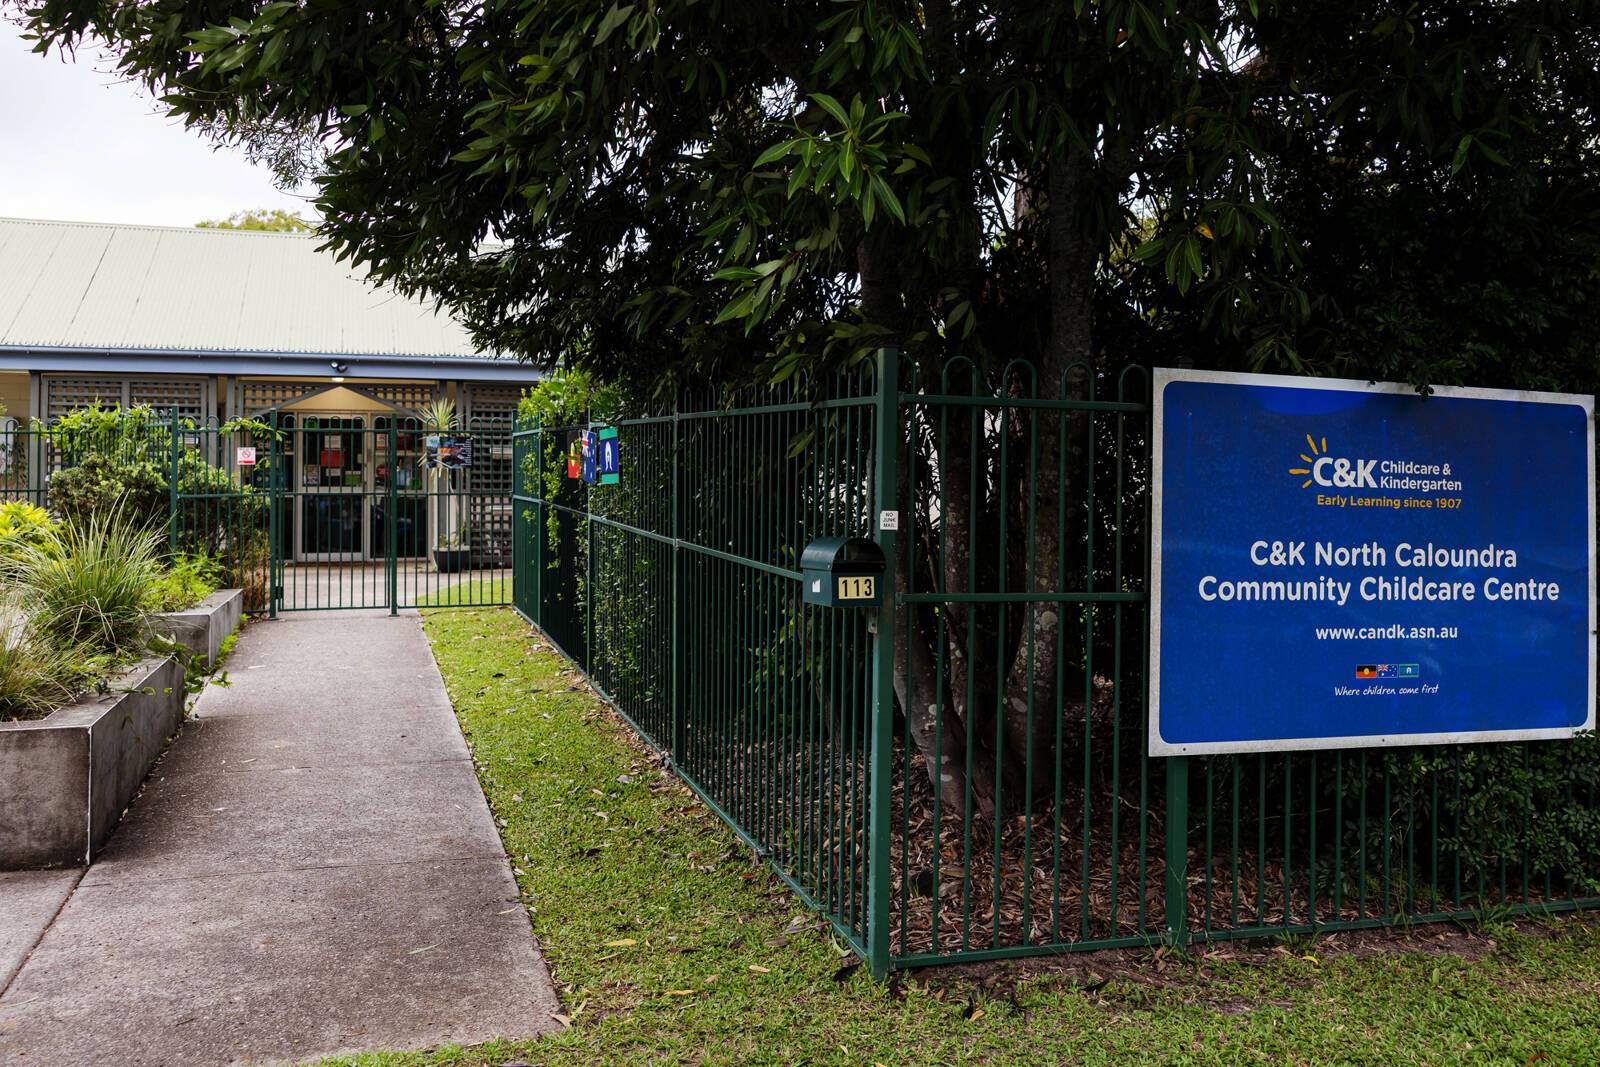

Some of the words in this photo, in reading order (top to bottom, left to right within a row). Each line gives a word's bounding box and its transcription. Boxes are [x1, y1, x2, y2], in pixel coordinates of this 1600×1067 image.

[1313, 456, 1379, 488] C&K
[1380, 460, 1440, 475] Childcare
[1442, 463, 1452, 476] &
[1380, 476, 1462, 492] Kindergarten
[1317, 494, 1347, 507] Early
[1350, 495, 1401, 509] Learning
[1403, 497, 1433, 508] since
[1436, 498, 1462, 509] 1907
[1250, 540, 1306, 566] C&K
[1315, 541, 1386, 566] North
[1395, 542, 1517, 568] Caloundra
[841, 578, 872, 597] 113
[1198, 575, 1351, 606] Community
[1360, 576, 1476, 601] Childcare
[1483, 577, 1560, 601] Centre
[1315, 624, 1458, 640] www.candk.asn.au
[1334, 686, 1361, 696] Where
[1362, 685, 1396, 695] children
[1421, 684, 1439, 694] first
